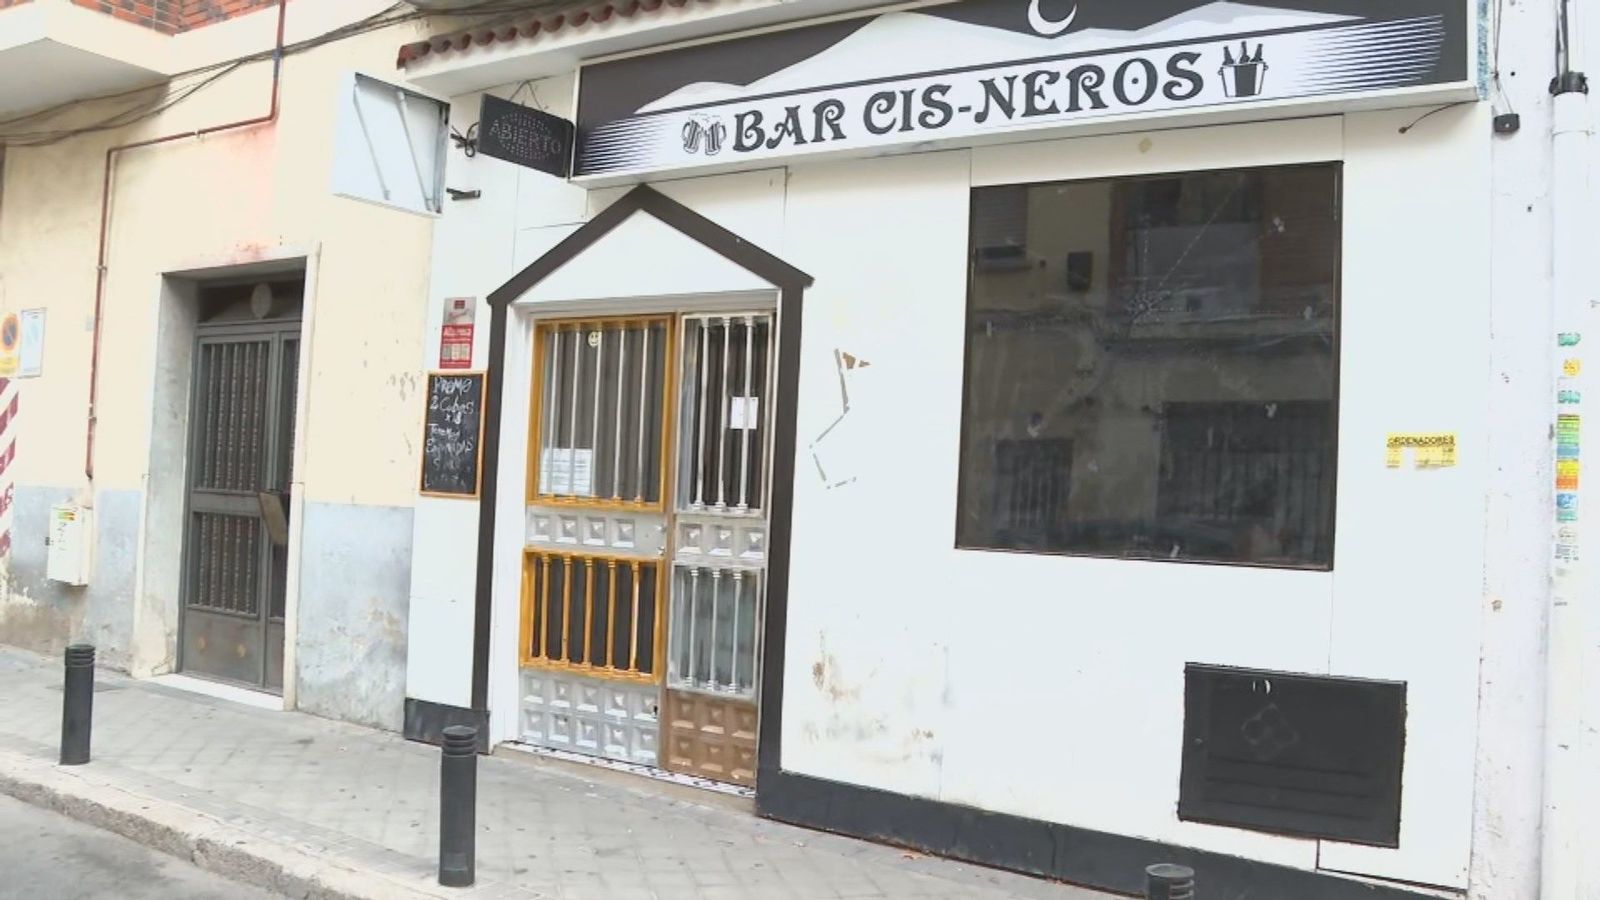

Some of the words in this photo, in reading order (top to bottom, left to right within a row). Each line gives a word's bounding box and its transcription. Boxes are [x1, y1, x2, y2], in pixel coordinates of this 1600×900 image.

[733, 99, 847, 153] BAR
[863, 52, 1204, 136] CIS-NEROS
[488, 119, 561, 154] ABIERTO
[429, 395, 439, 410] 2
